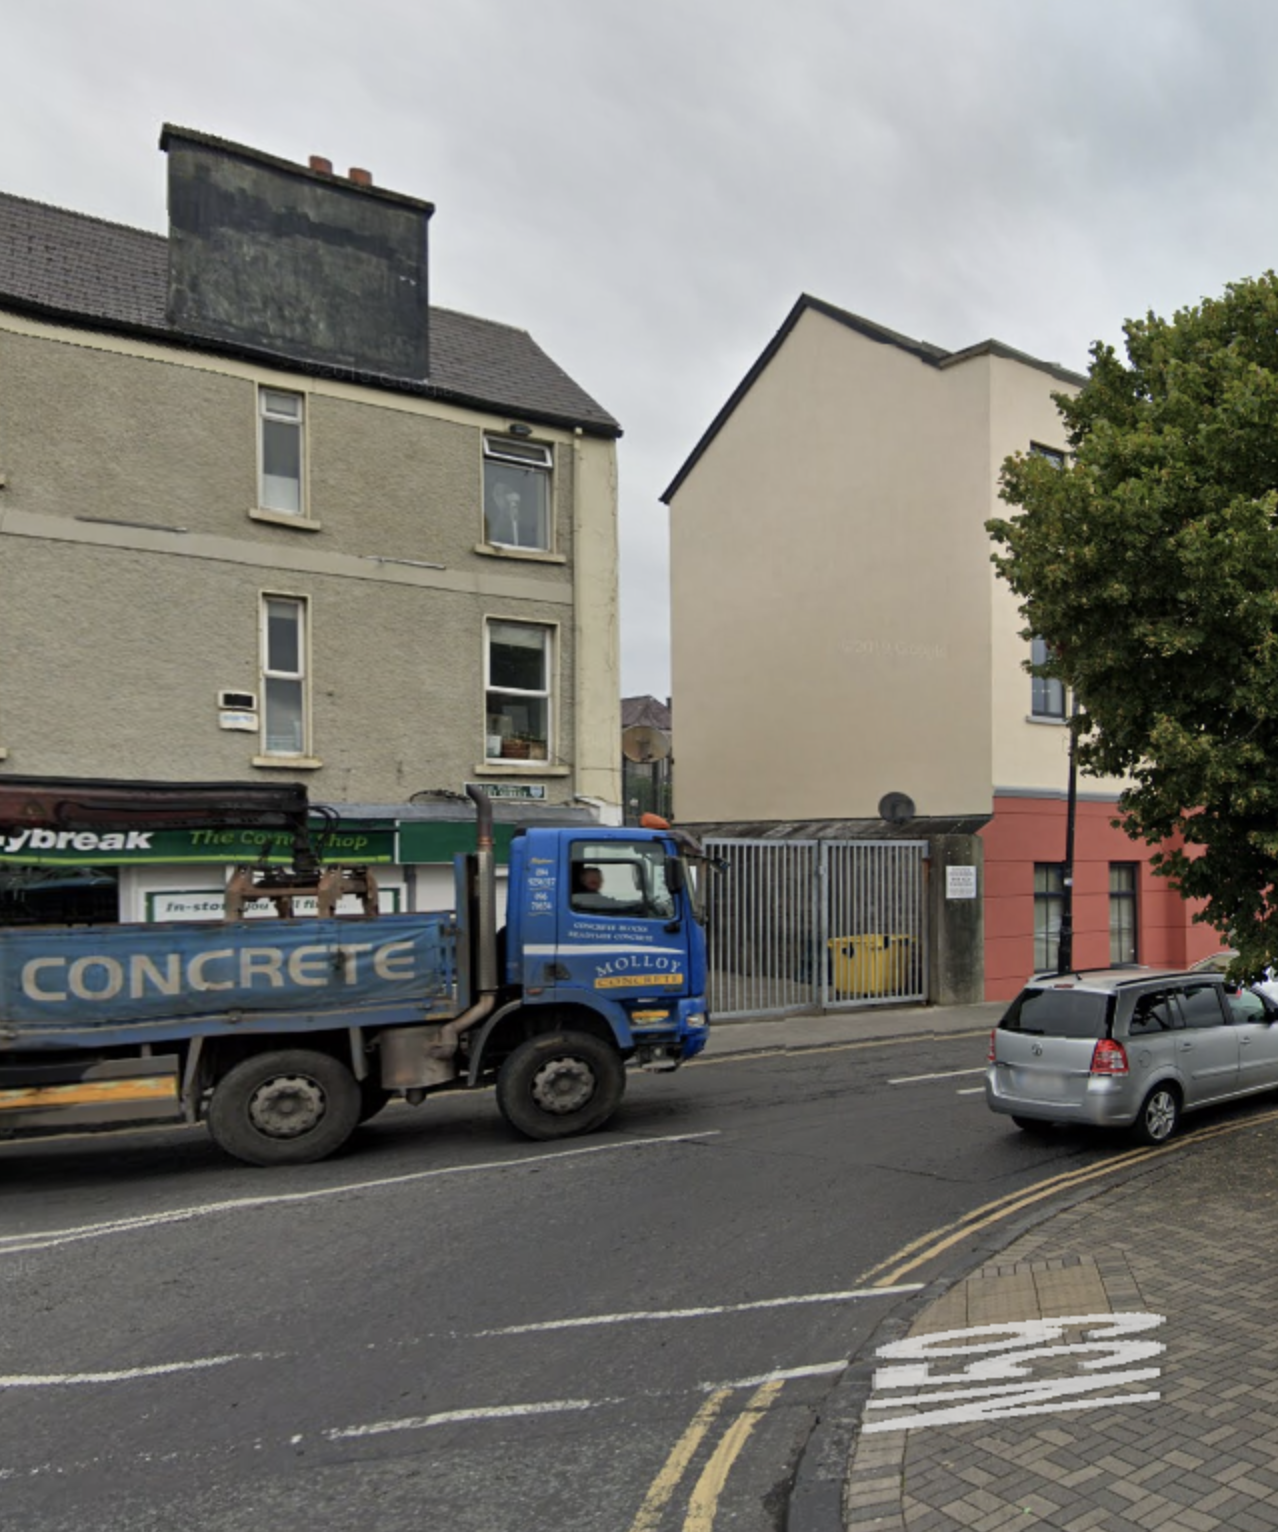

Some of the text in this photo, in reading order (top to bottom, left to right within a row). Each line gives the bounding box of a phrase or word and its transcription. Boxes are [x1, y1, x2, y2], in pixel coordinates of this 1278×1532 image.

[0, 828, 155, 853] ybreak
[186, 827, 236, 846] The
[322, 831, 368, 851] hop
[573, 921, 616, 932] CONCRETE
[21, 941, 415, 1001] CONCRETE
[596, 955, 681, 977] MOLLOY
[597, 974, 678, 987] CONCRETE
